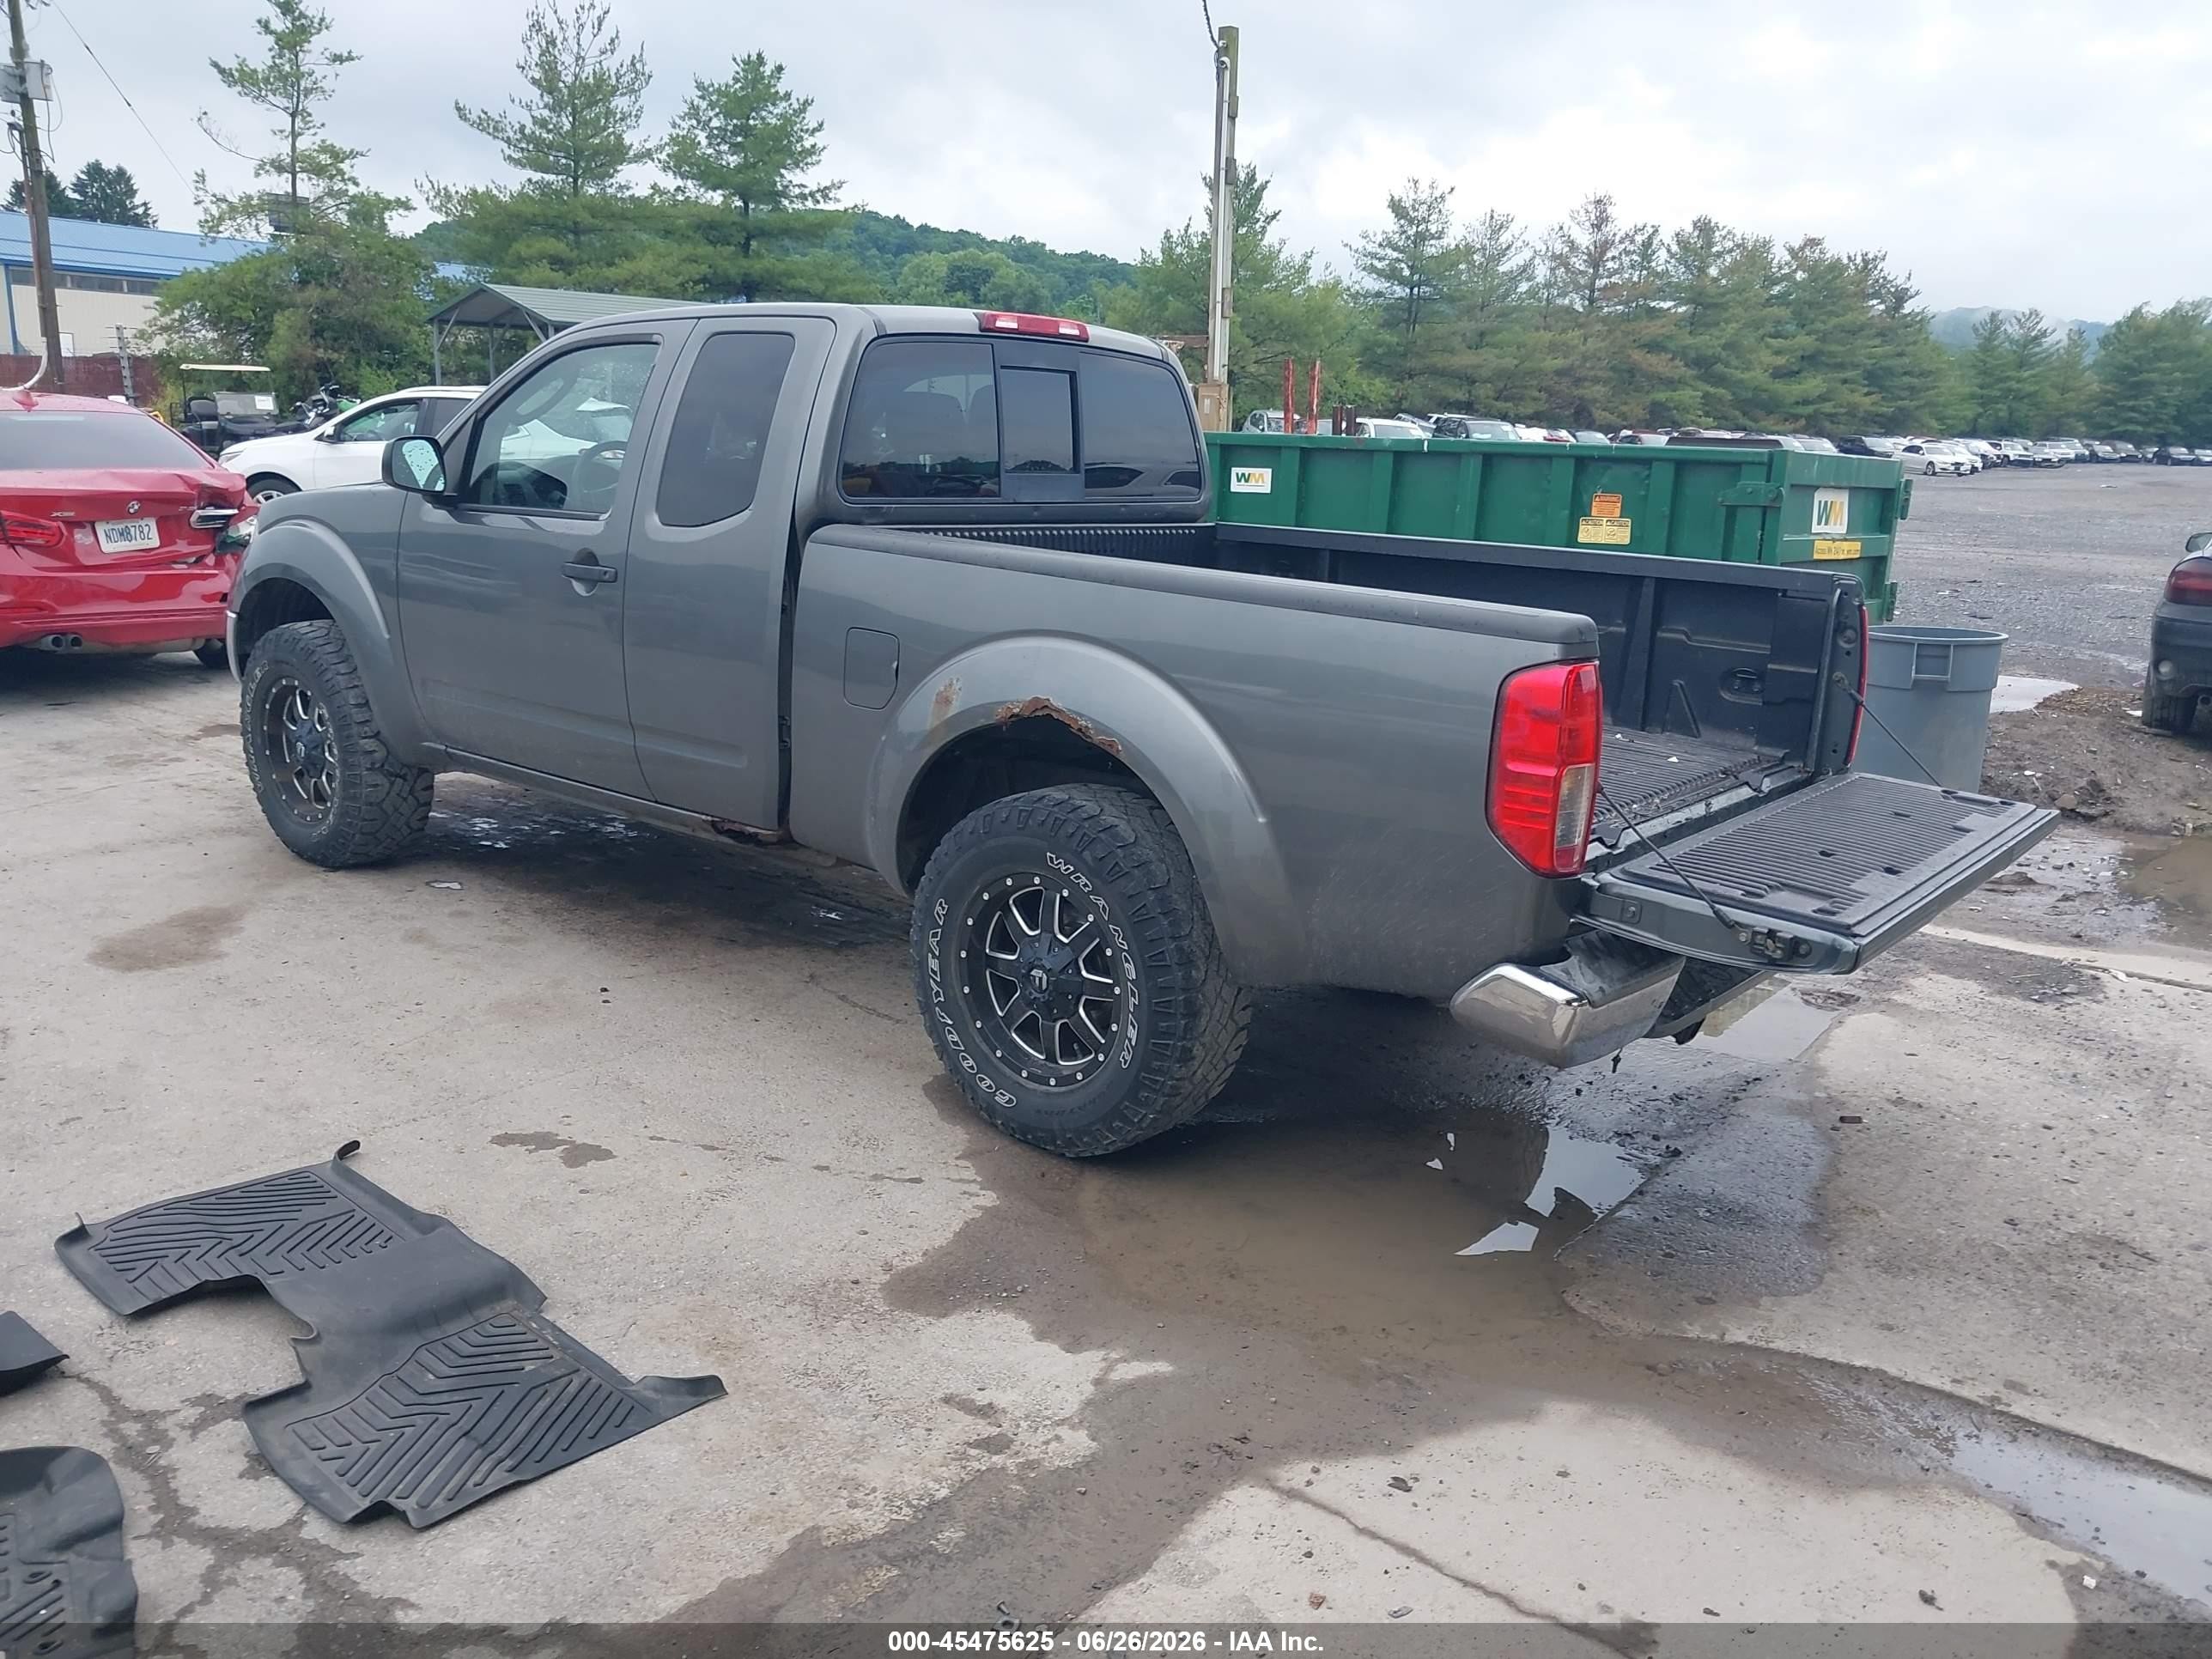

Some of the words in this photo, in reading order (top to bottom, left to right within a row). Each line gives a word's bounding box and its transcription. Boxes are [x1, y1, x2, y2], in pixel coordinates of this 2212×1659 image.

[1235, 471, 1265, 483] WM
[1816, 500, 1844, 526] WM
[103, 524, 153, 544] NDM8782
[1046, 851, 1139, 1069] WRANGLER
[927, 898, 1018, 1107] GOODYEAR
